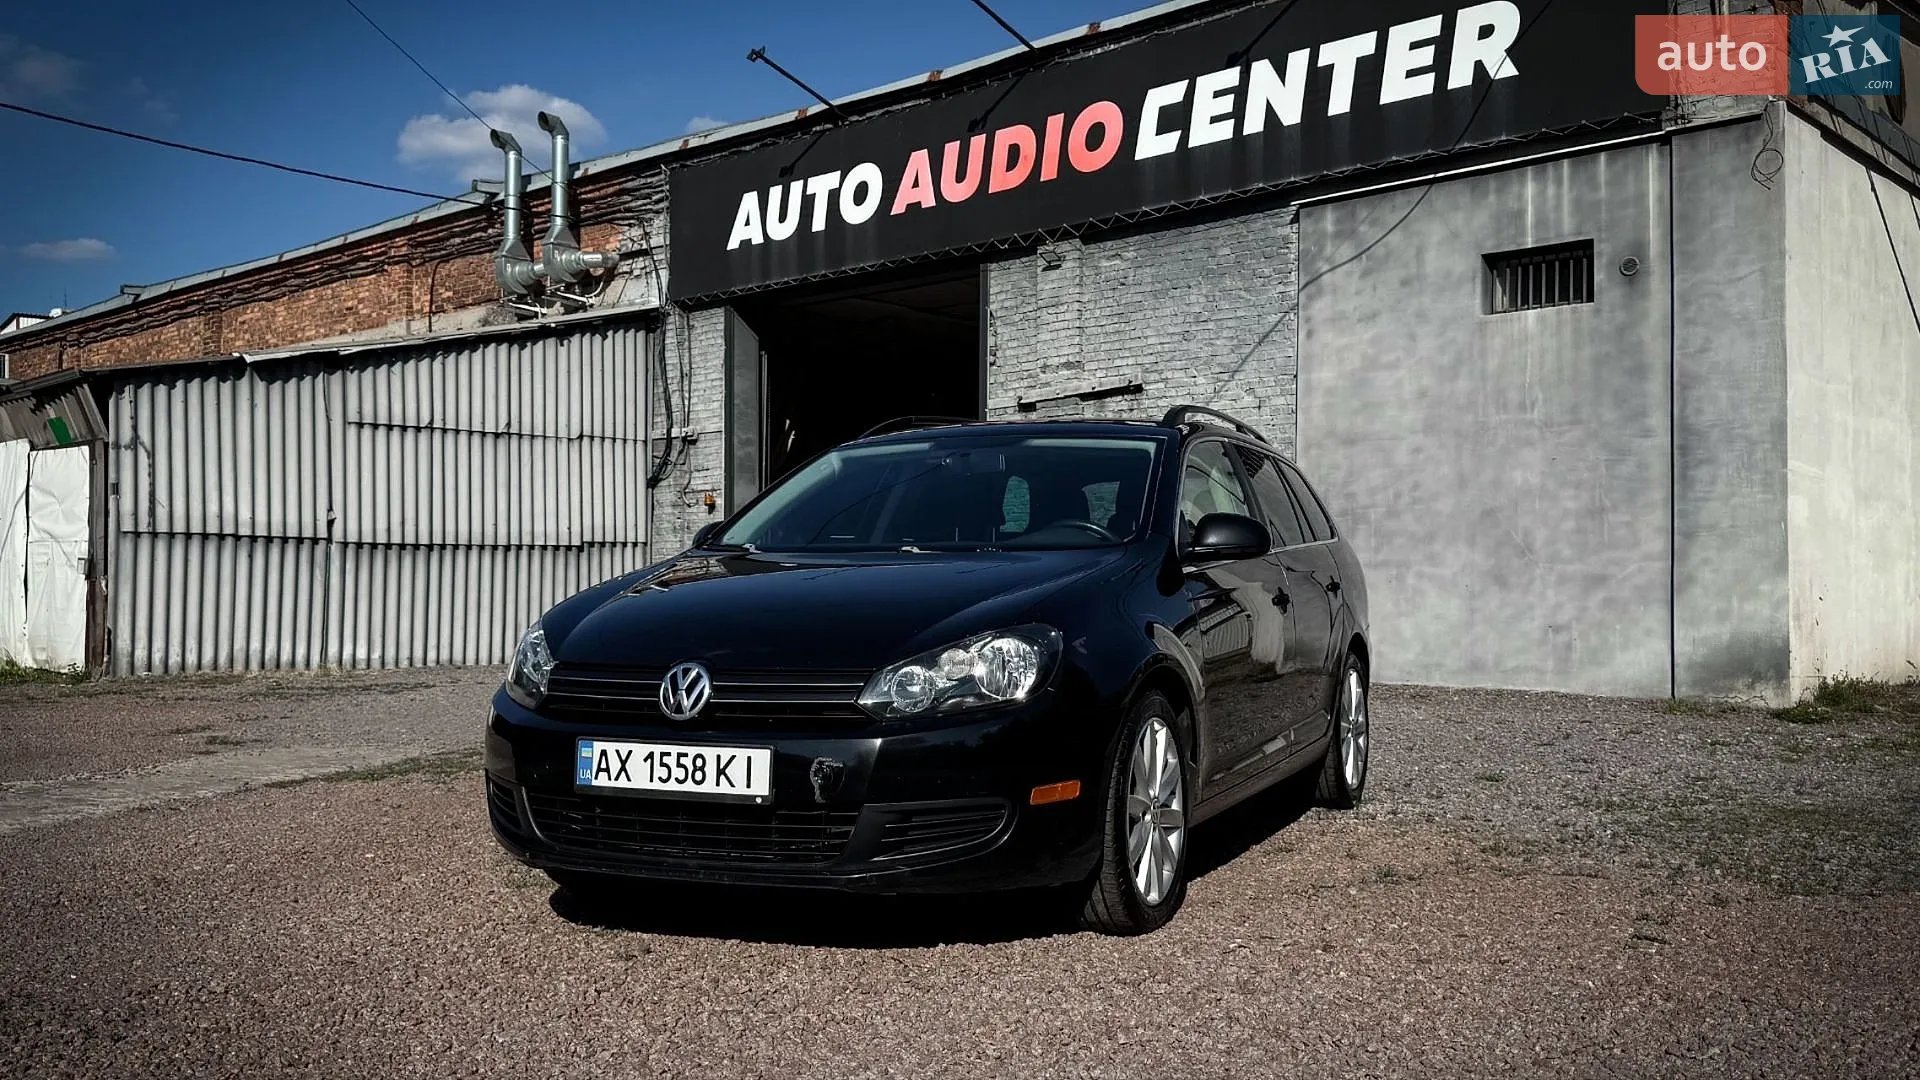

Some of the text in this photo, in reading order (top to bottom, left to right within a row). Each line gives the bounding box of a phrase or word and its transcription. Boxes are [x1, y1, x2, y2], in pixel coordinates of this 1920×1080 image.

[726, 0, 1521, 250] AUTO AUDIO CENTER
[580, 768, 591, 779] UA
[594, 749, 633, 782] AX
[643, 751, 707, 786] 1558
